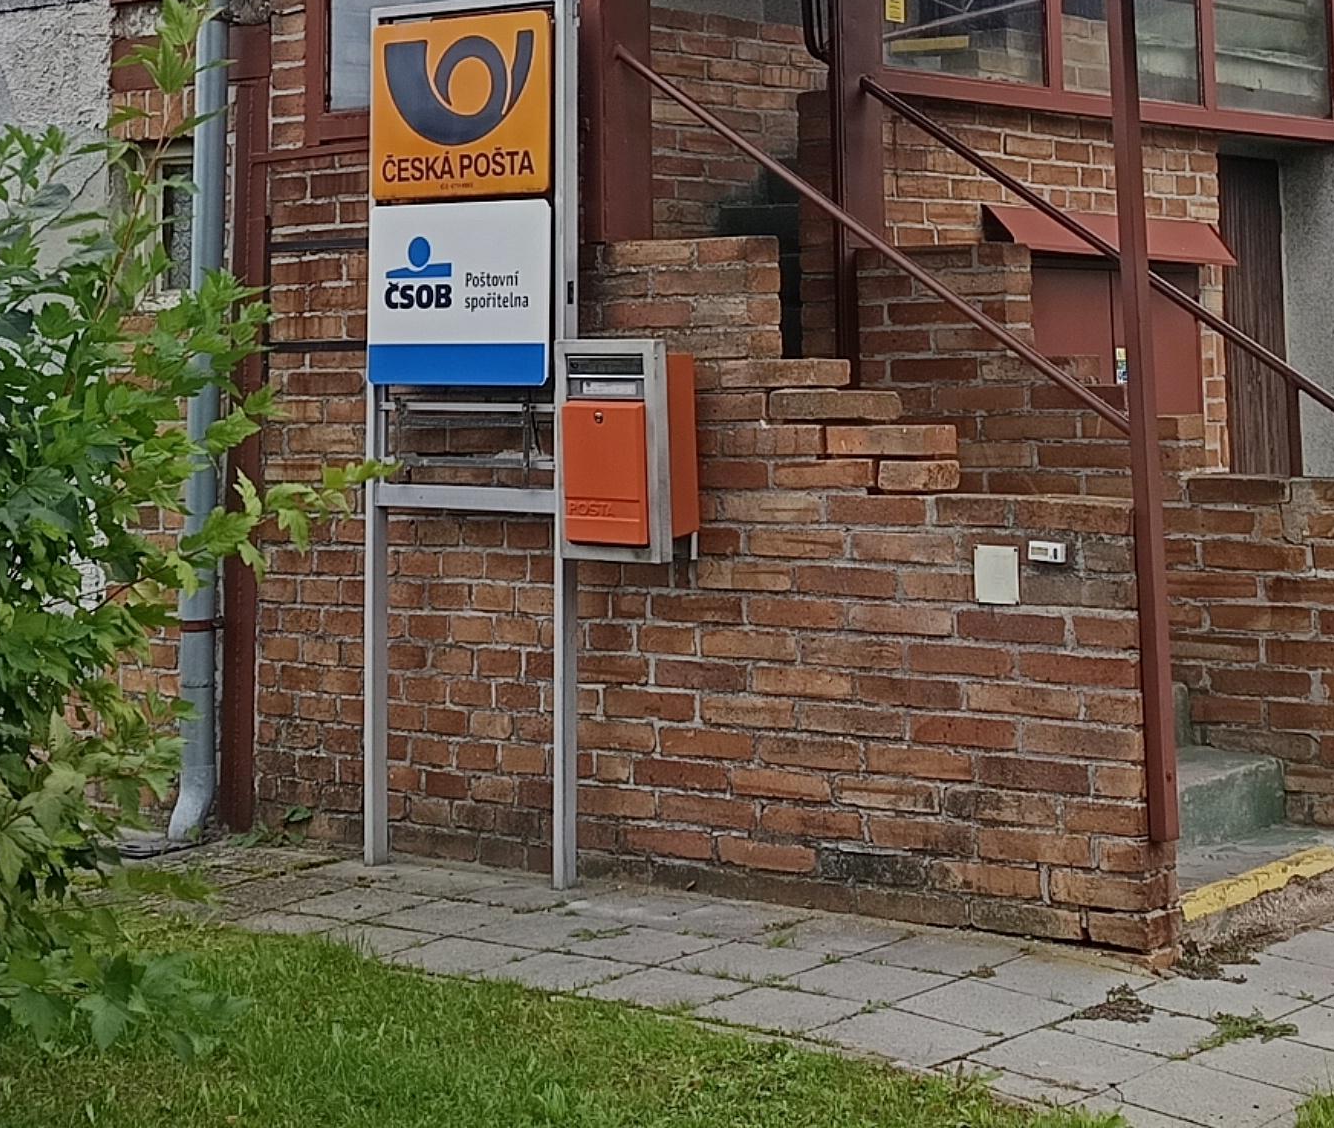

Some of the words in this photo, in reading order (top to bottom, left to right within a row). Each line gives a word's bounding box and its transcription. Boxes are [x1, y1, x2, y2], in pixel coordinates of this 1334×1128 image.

[382, 152, 454, 183] ČESKÁ
[459, 147, 535, 178] POŠTA
[464, 271, 519, 288] Poštovní
[384, 281, 452, 309] ČSOB
[464, 292, 529, 312] spořitelna
